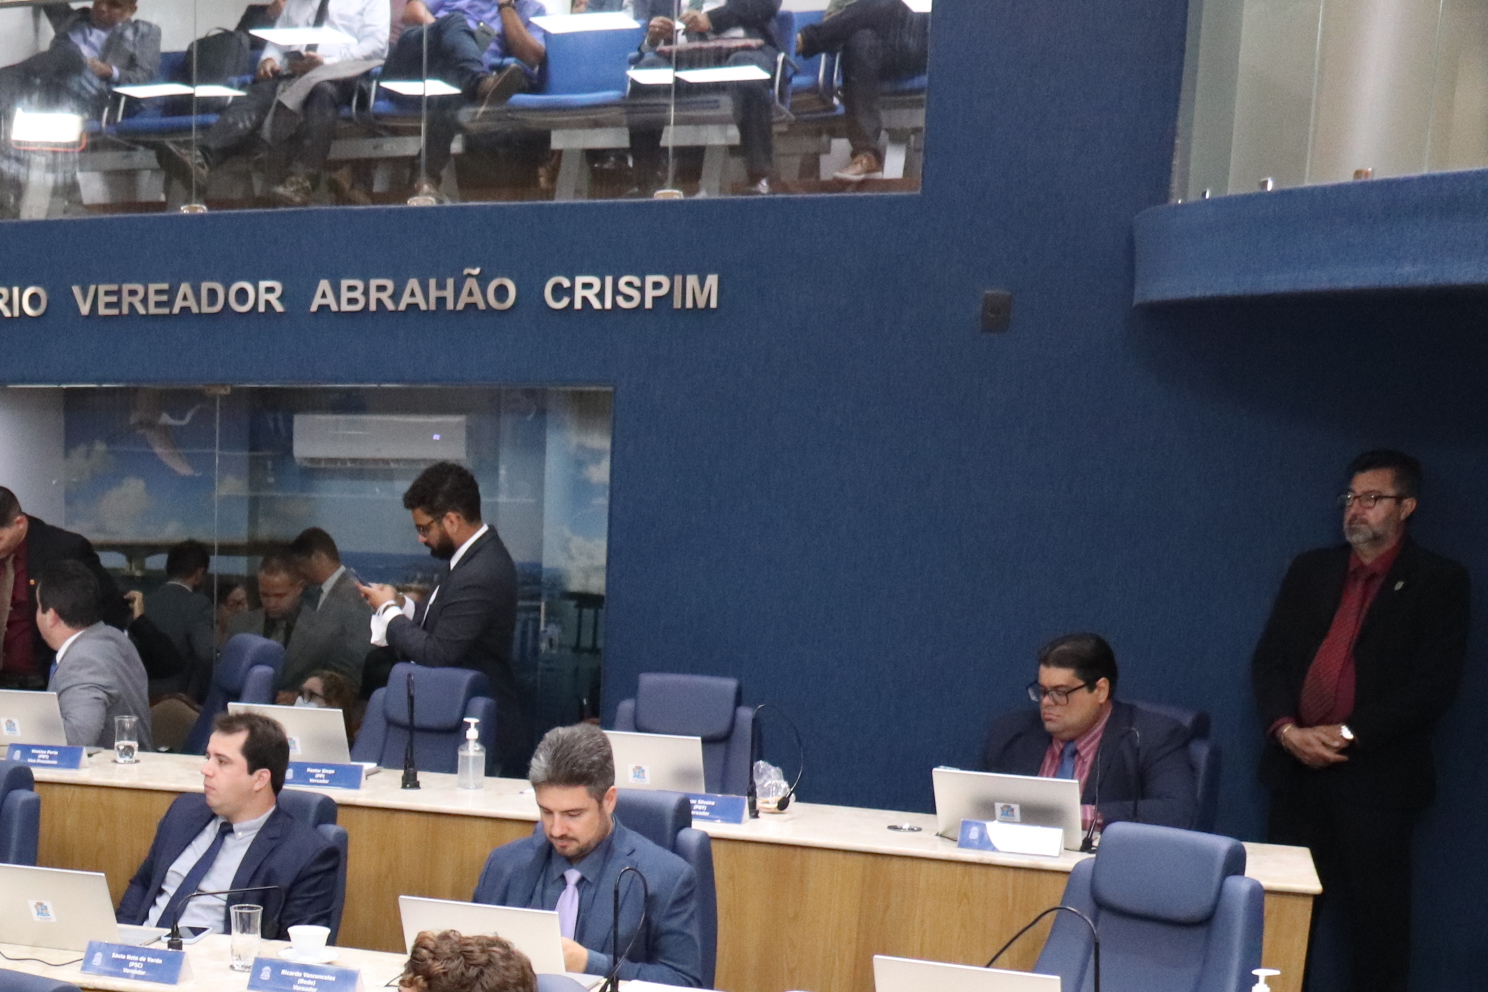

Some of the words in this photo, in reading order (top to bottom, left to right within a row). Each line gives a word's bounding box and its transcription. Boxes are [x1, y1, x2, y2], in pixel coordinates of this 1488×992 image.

[71, 280, 286, 316] VEREADOR
[309, 267, 517, 313] ABRAHÃO
[544, 274, 719, 310] CRISPIM
